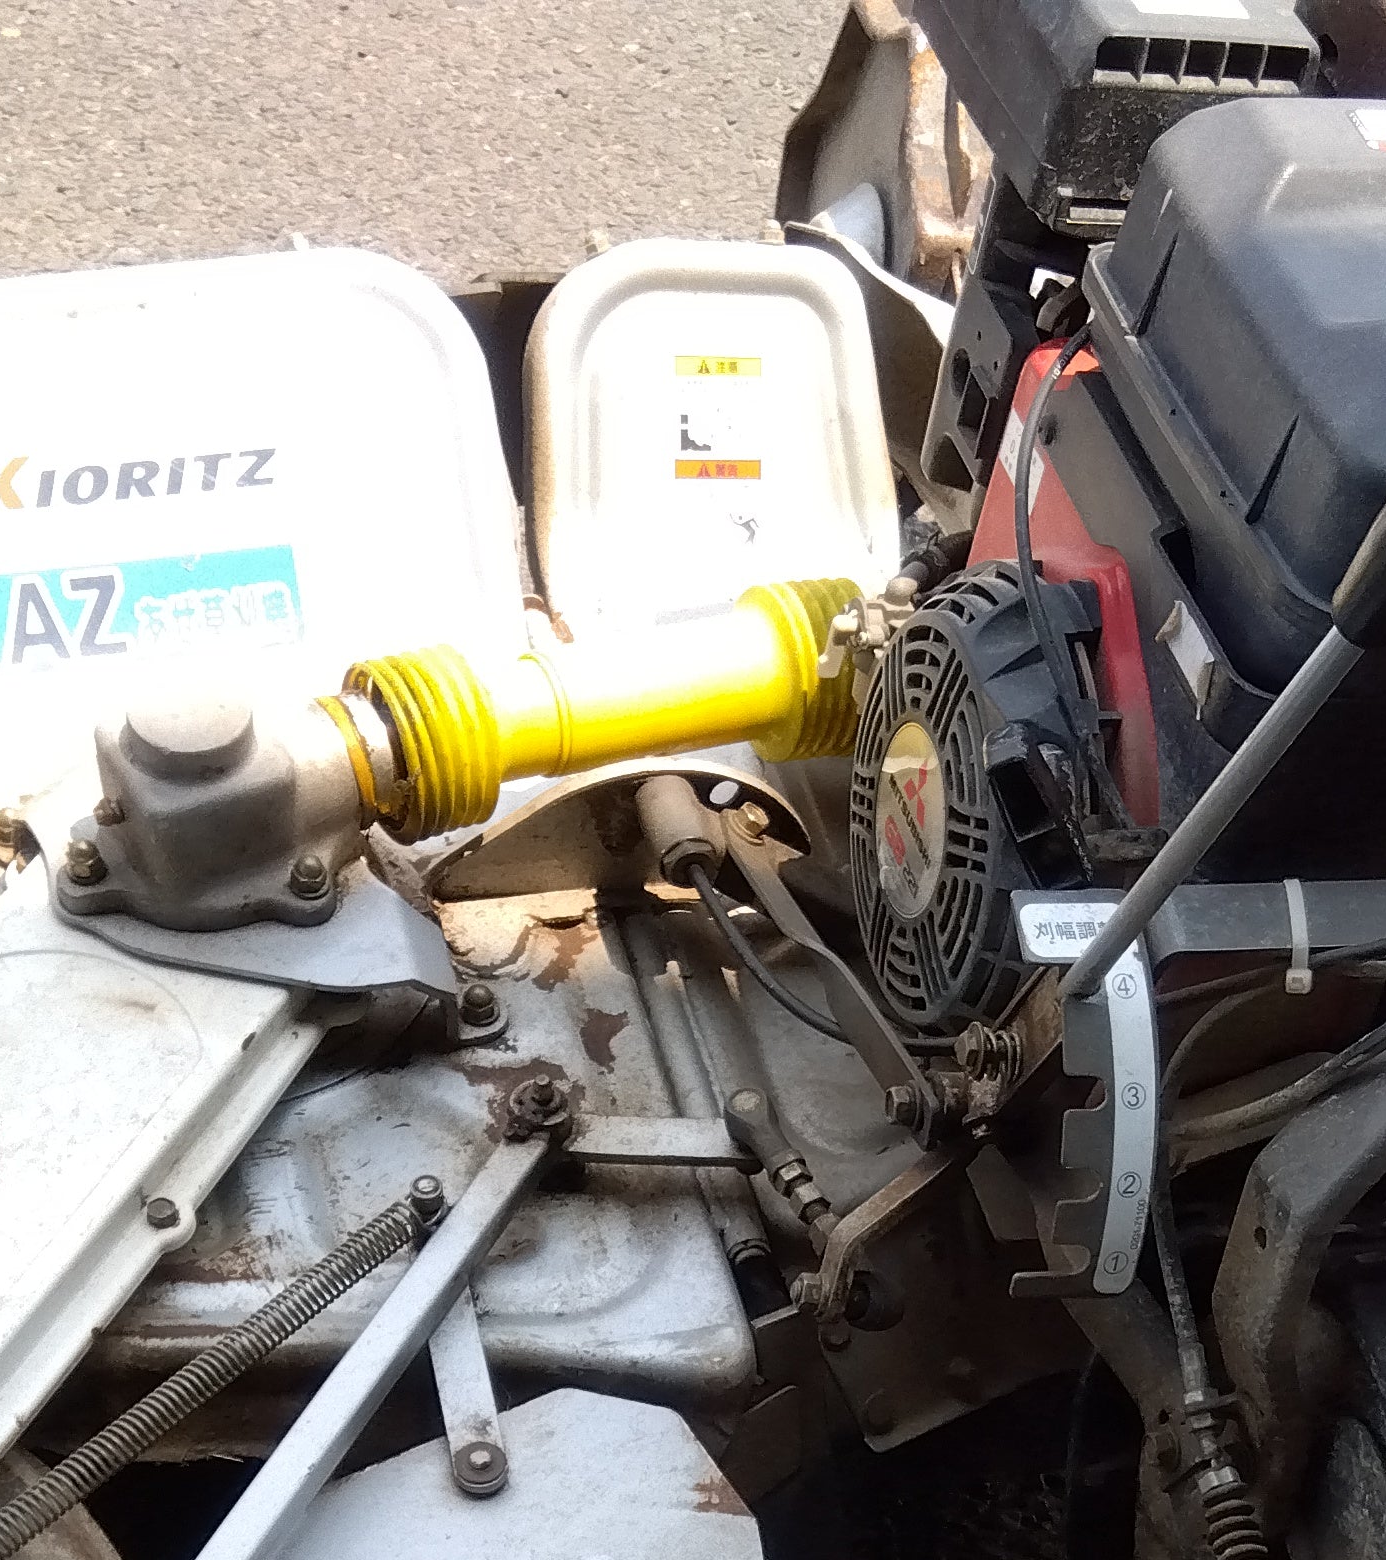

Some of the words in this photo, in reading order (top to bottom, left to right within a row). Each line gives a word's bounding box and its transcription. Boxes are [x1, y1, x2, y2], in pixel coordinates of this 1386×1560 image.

[13, 574, 127, 665] AZ
[1034, 921, 1106, 942] 刈幅調
